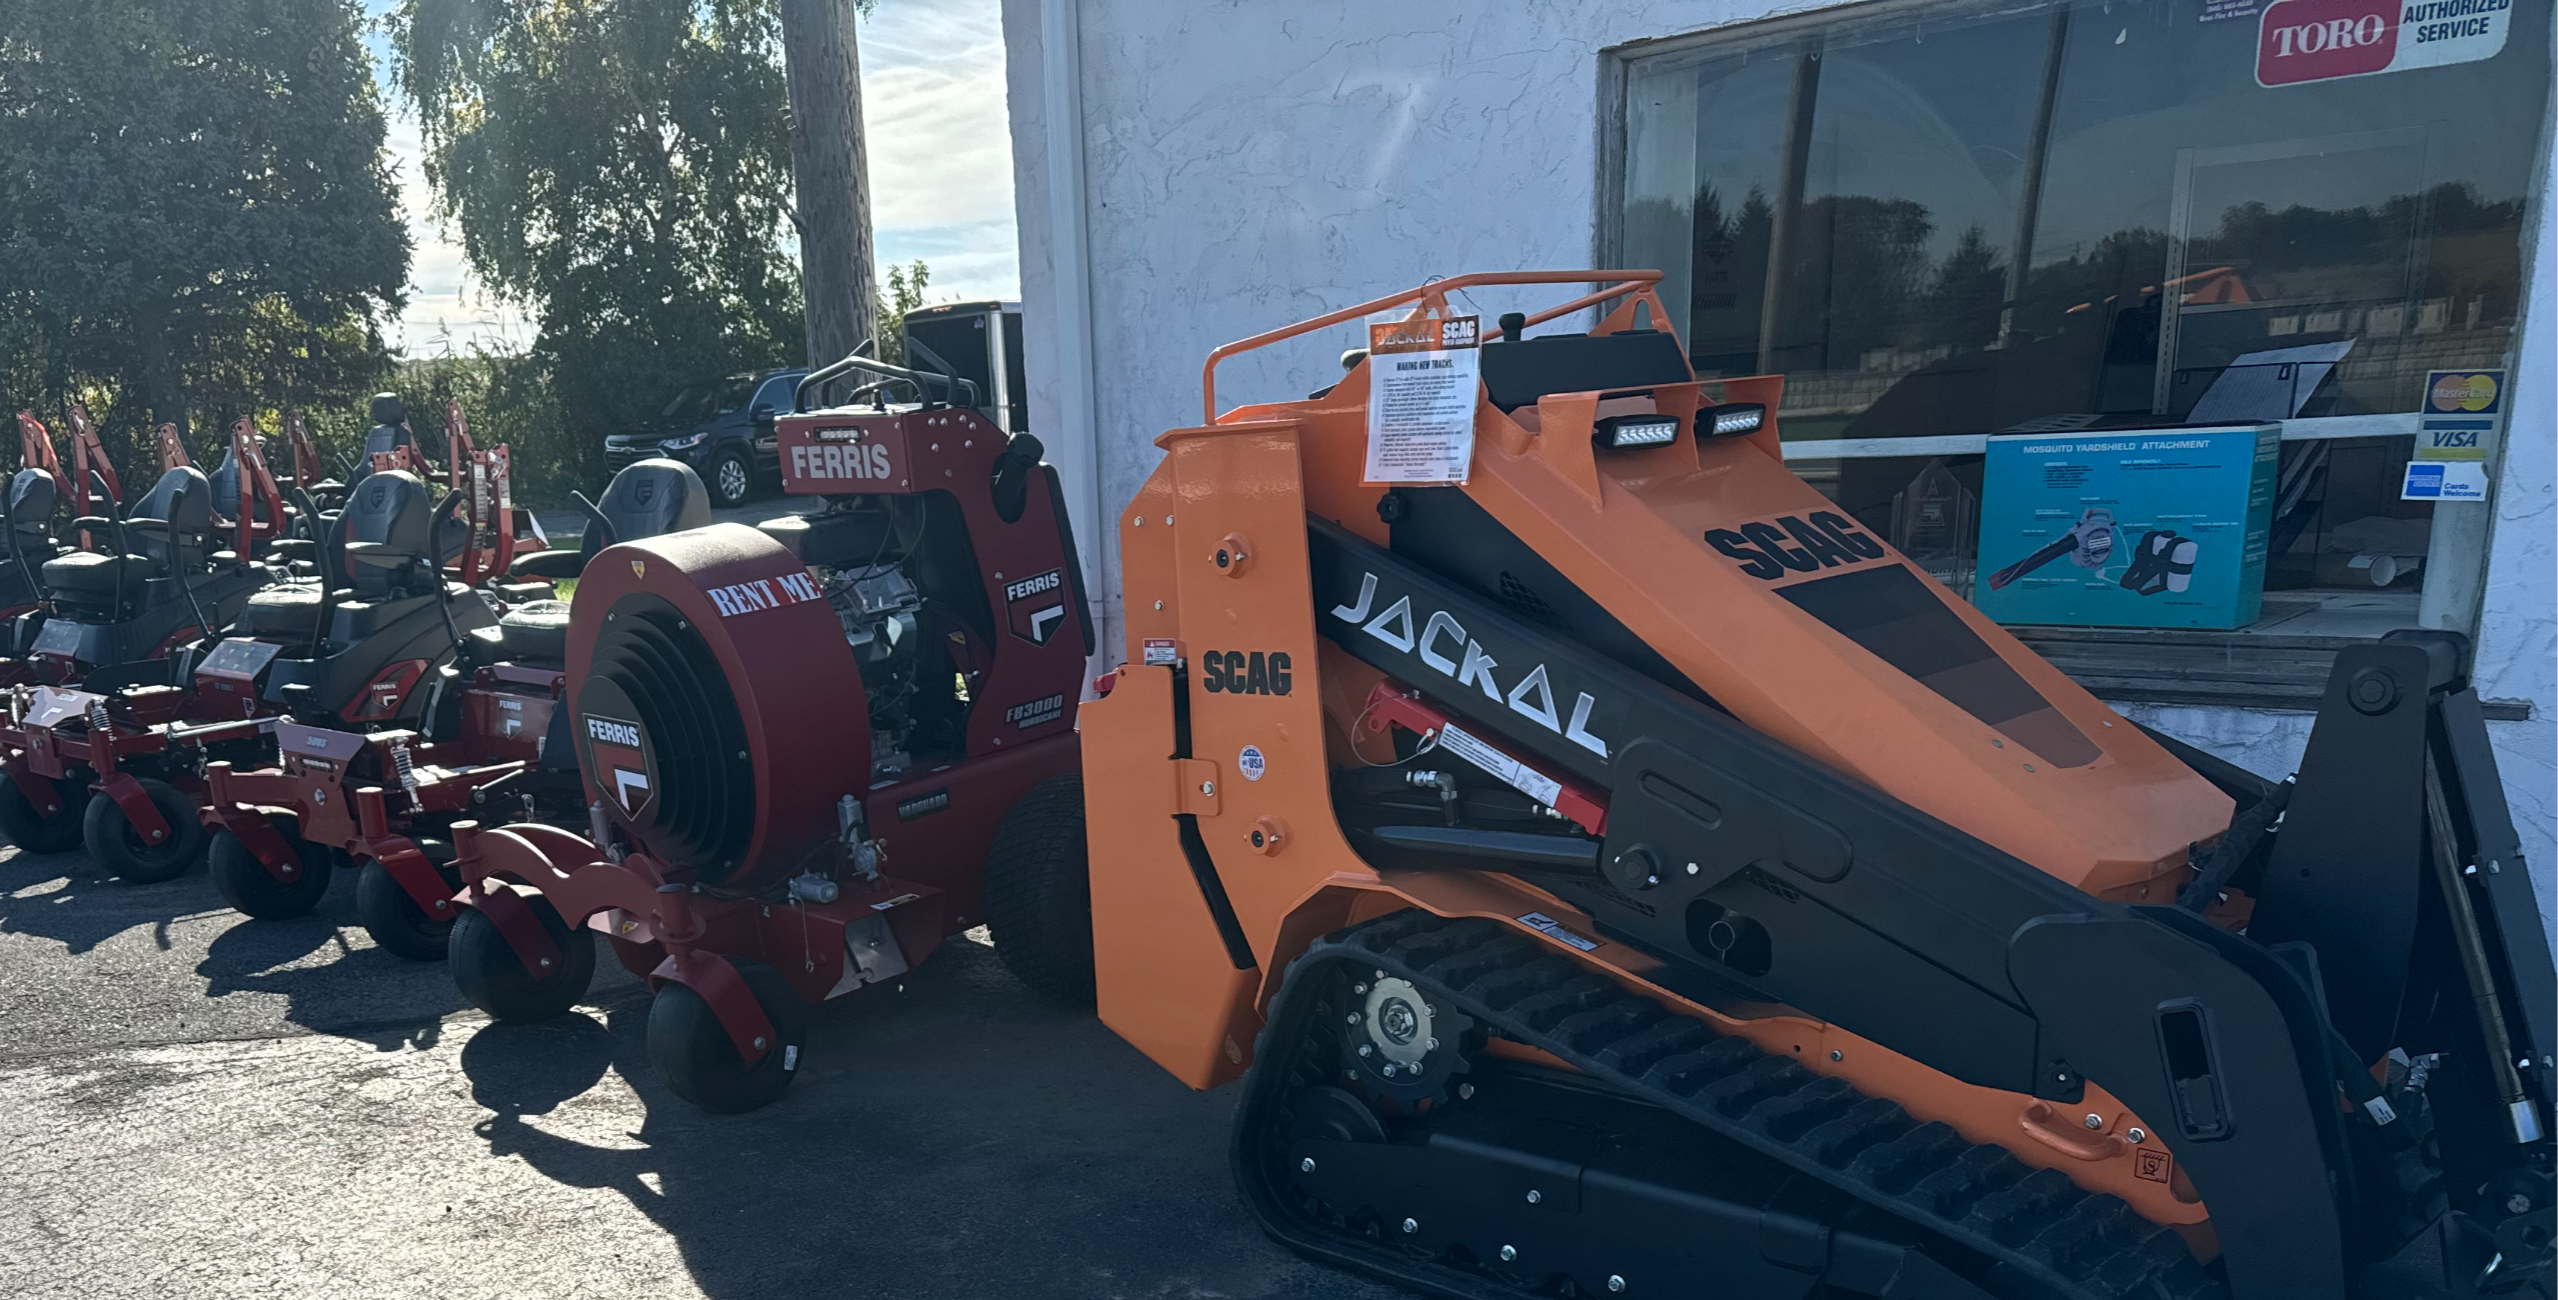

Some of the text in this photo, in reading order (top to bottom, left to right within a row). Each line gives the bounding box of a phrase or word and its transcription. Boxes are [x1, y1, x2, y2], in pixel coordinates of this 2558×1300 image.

[2403, 0, 2509, 24] AUTHORIZED
[2272, 13, 2385, 58] TORO
[2416, 17, 2490, 44] SERVICE
[1376, 330, 1436, 347] JACKAL
[1442, 320, 1476, 339] SCAG
[1396, 361, 1418, 371] MAKING
[1419, 360, 1431, 370] NEW
[2432, 387, 2495, 399] MasterCard
[2023, 440, 2211, 454] MOSQUITO YARDSHIELD ATTACHMENT
[2432, 431, 2479, 448] VISA
[790, 443, 891, 480] FERRIS
[1704, 511, 1885, 580] SCAG
[706, 572, 821, 617] RENT ME
[1007, 572, 1060, 601] FERRIS
[1203, 650, 1292, 696] SCAG
[1330, 571, 1609, 759] JACKAL
[373, 683, 397, 691] FERRIS
[500, 700, 521, 711] FERRIS
[1005, 694, 1064, 723] FB3000
[1018, 709, 1062, 729] HURRICANE
[587, 718, 640, 747] FERRIS
[1248, 758, 1263, 769] USA
[898, 793, 948, 819] VANGUARD
